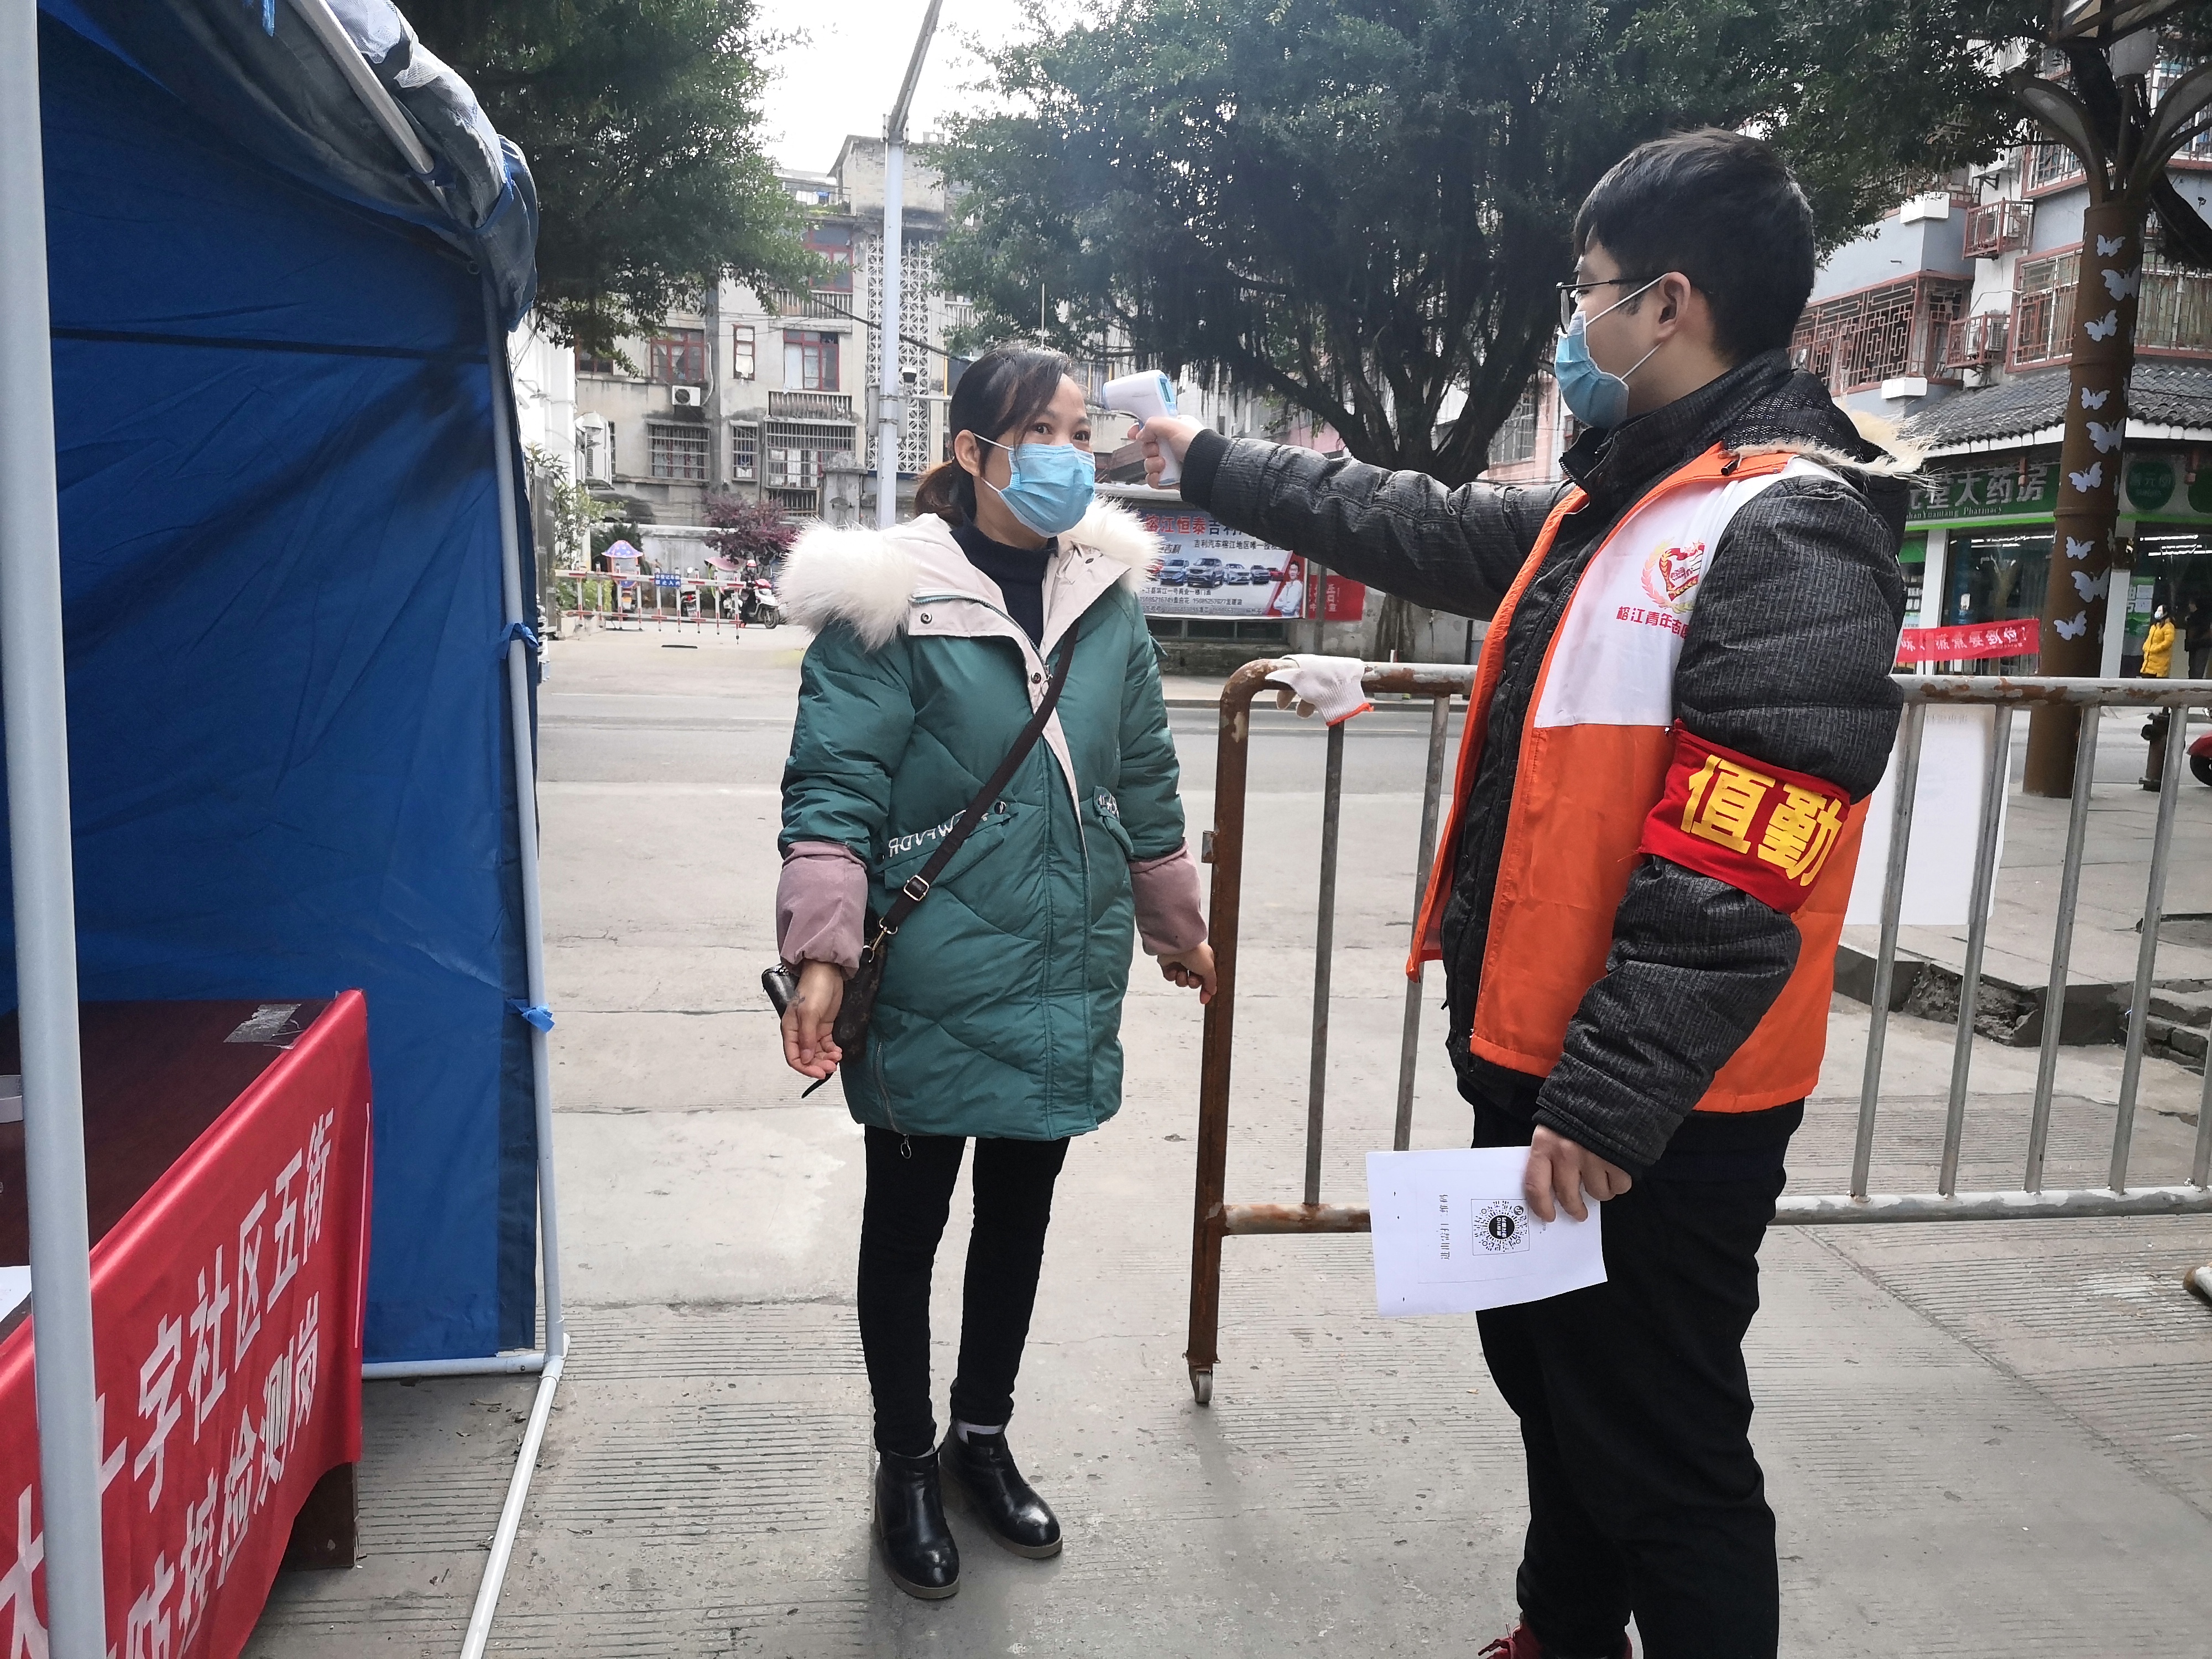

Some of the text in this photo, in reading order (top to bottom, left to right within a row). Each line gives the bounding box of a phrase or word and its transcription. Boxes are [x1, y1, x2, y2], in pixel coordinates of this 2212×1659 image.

[1964, 506, 2002, 515] Pharmacy
[1680, 754, 1843, 886] 值勤
[1439, 1193, 1451, 1261] 进出需扫二维码
[105, 1292, 320, 1659] 防控检测岗
